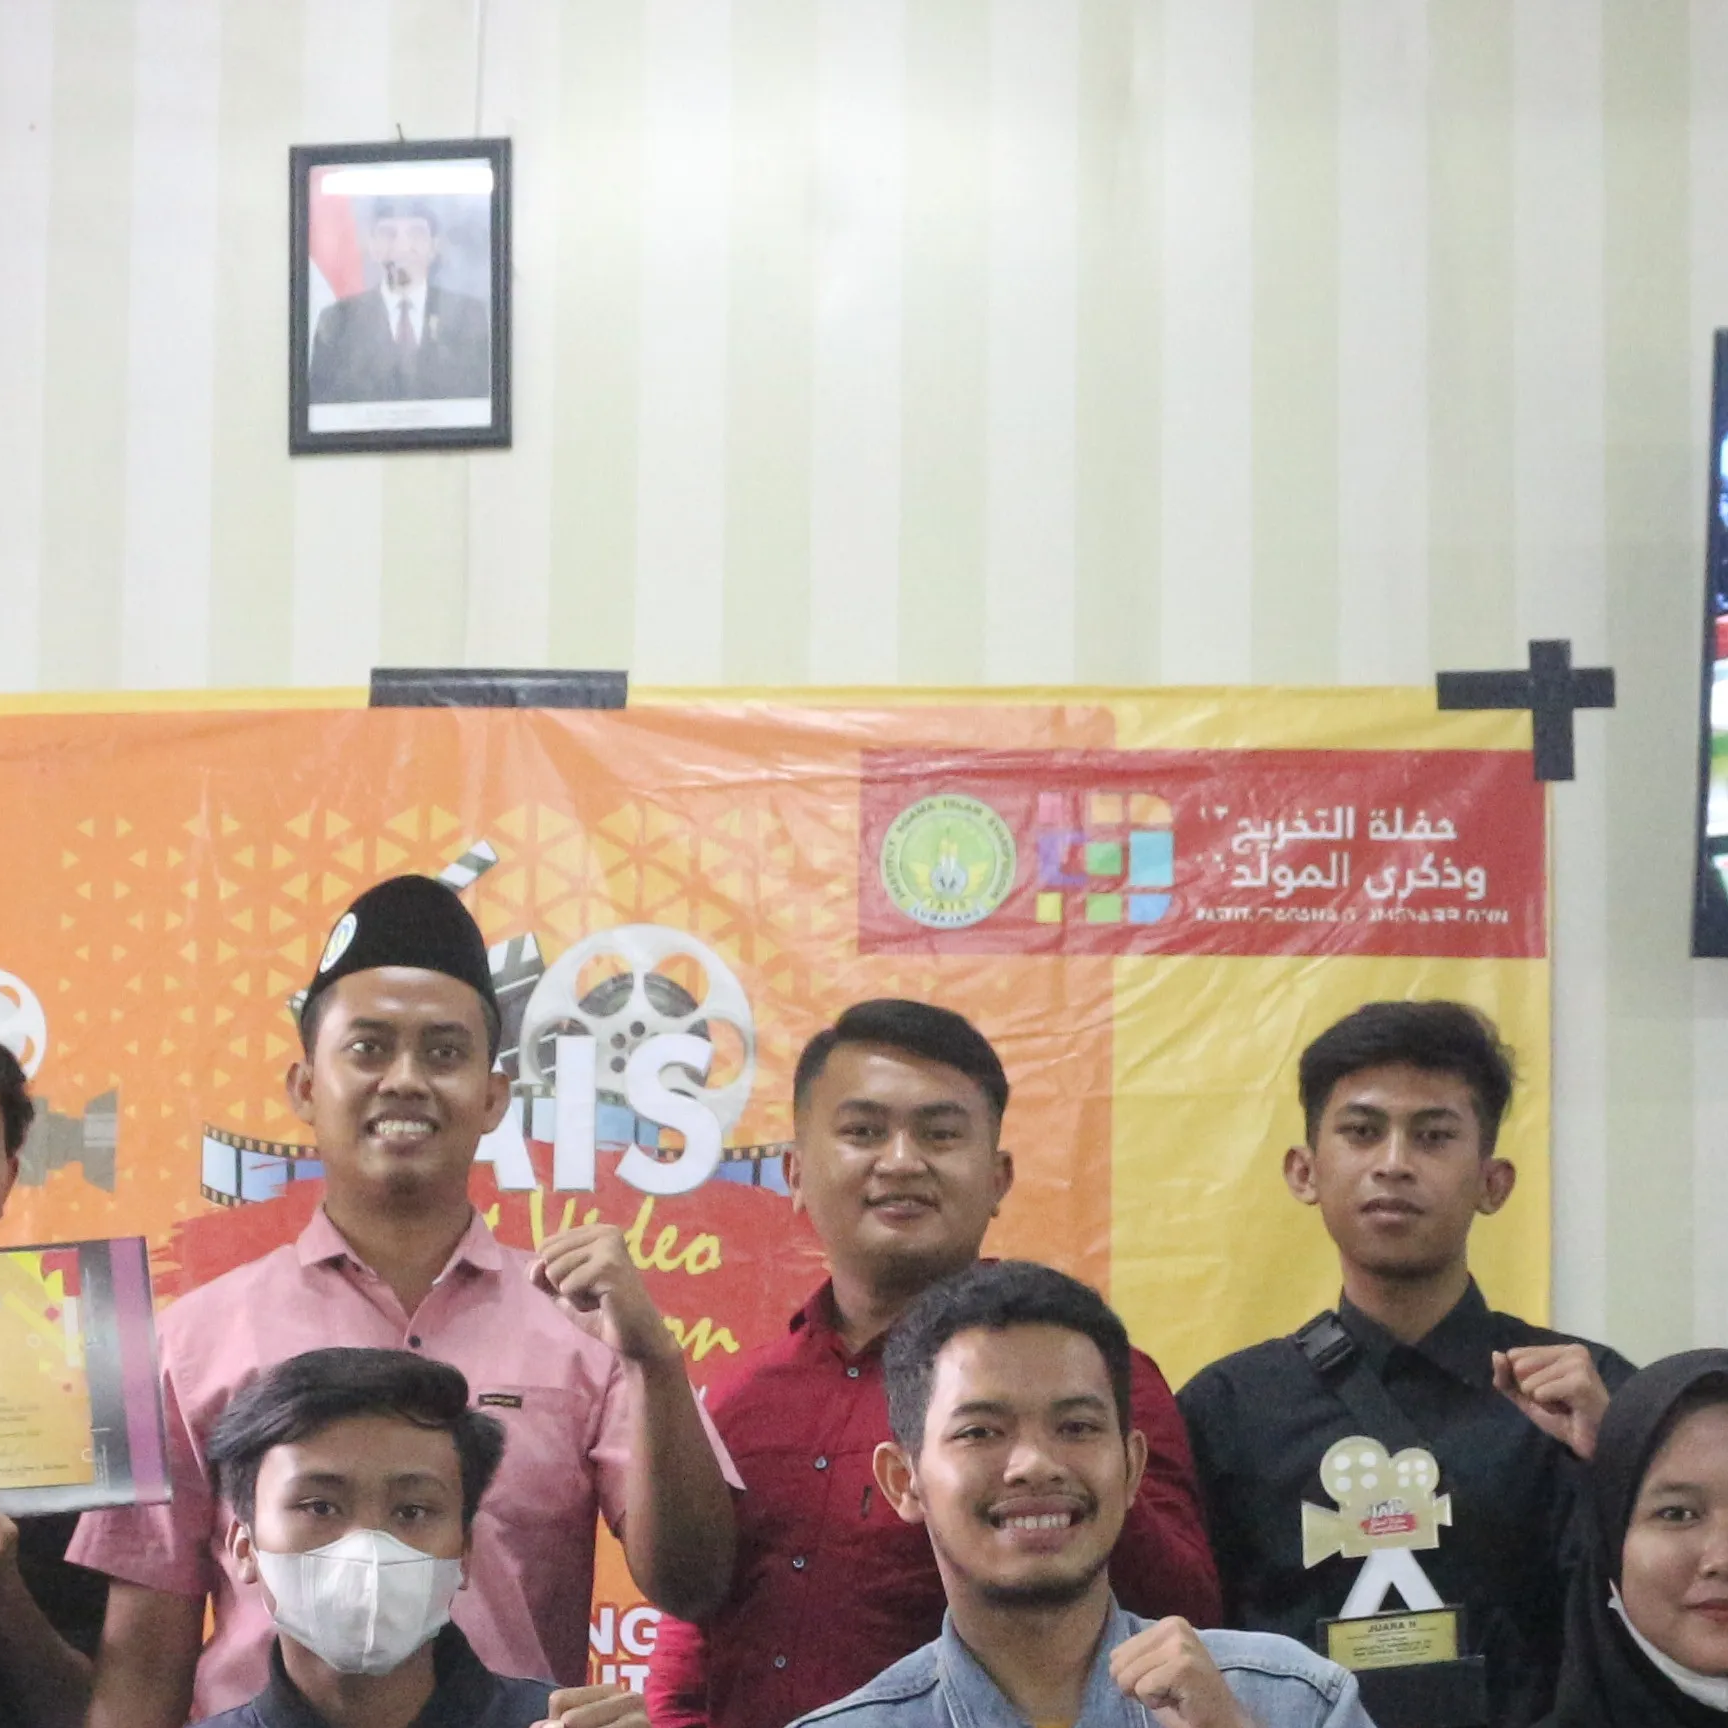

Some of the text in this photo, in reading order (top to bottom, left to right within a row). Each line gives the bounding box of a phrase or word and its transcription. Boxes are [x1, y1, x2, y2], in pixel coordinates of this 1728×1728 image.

[1231, 805, 1458, 854] حفلة التخريج
[1231, 849, 1351, 898] المولد
[474, 1033, 722, 1195] AIS
